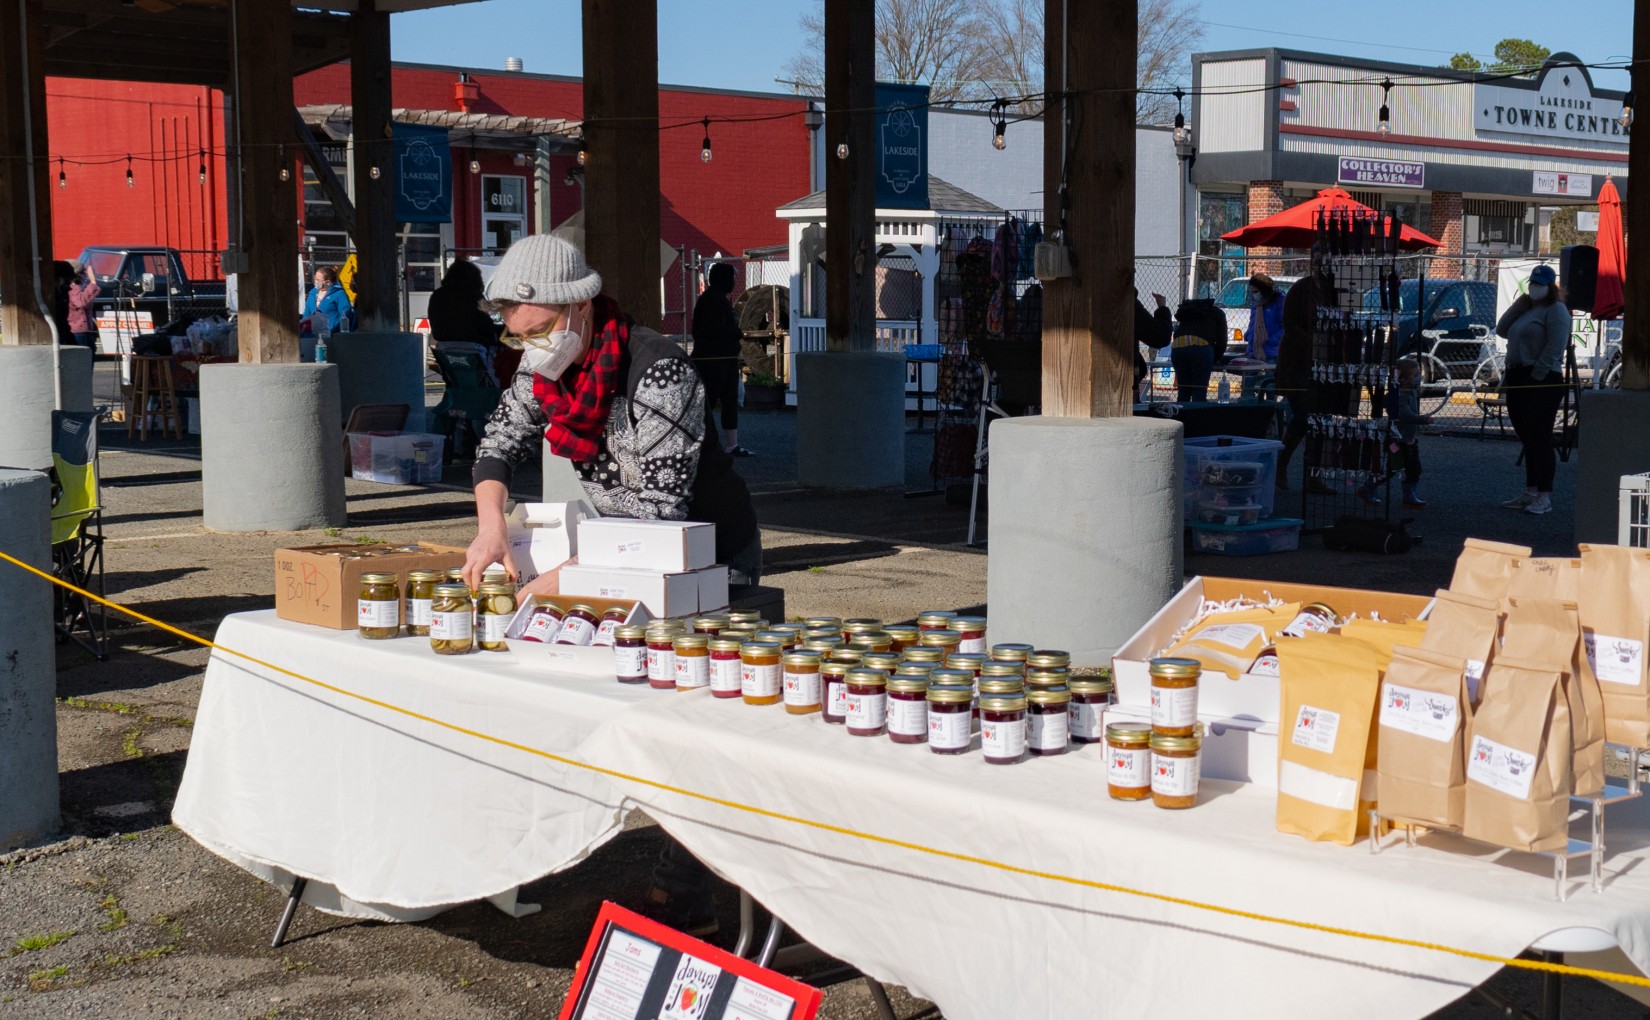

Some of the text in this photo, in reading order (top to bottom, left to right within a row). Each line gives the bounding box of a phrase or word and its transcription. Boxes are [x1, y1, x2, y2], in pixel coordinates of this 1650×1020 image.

[1540, 95, 1592, 110] LAKESIDE
[1494, 105, 1557, 129] TOWNE
[884, 146, 918, 156] LAKESIDE
[1341, 160, 1421, 175] COLLECTOR'S
[403, 172, 440, 181] LAKESIDE
[1356, 171, 1407, 184] HEAVEN
[1538, 176, 1555, 191] twig
[491, 192, 514, 206] 6110
[625, 942, 642, 957] Jams
